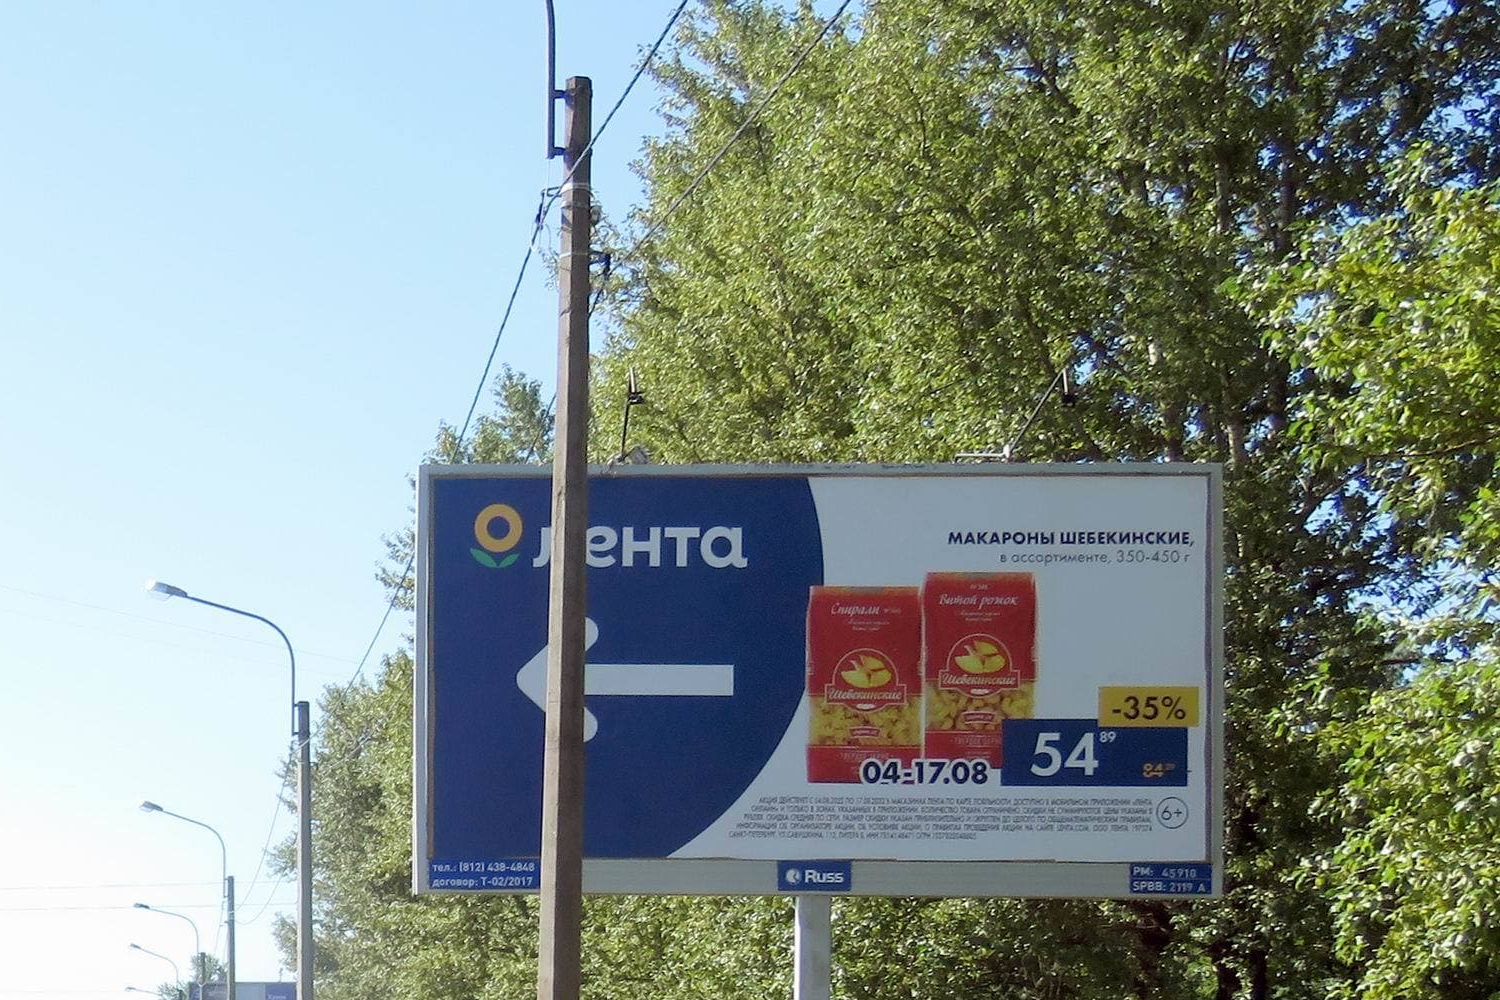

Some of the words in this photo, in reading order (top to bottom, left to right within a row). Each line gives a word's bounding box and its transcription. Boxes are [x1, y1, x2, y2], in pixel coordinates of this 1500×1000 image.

[948, 531, 1055, 545] МАКАРОНЫ
[1059, 531, 1195, 547] ШЕБЕКИНСКИЕ,
[1000, 553, 1007, 563] в
[1011, 553, 1111, 566] ассортименте,
[1116, 549, 1180, 563] 350-450
[1183, 553, 1191, 563] г
[831, 602, 880, 617] Спирали
[1112, 695, 1186, 721] -35%
[1030, 732, 1099, 777] 54
[1099, 731, 1117, 743] 89
[863, 761, 988, 785] 04-17.08
[1160, 806, 1182, 821] 6+
[459, 861, 484, 872] (812)
[487, 861, 535, 872] 438-4848
[1161, 867, 1197, 879] 45910
[432, 878, 479, 888] договор:
[804, 869, 844, 883] Russ
